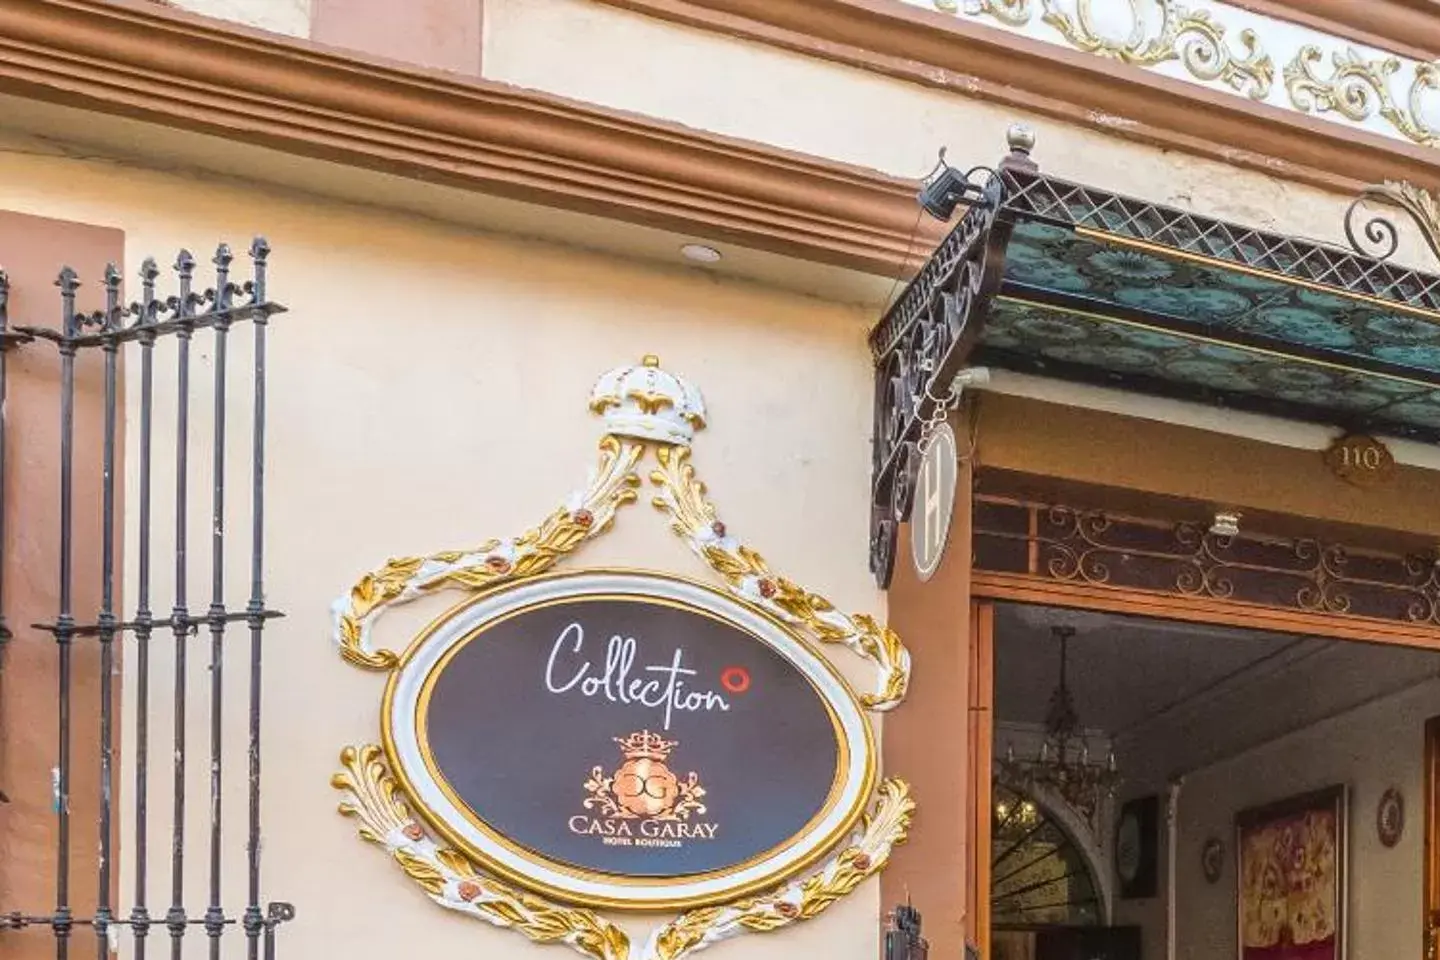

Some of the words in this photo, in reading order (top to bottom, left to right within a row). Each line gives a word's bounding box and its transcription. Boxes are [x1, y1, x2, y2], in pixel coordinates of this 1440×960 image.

[1342, 446, 1380, 469] 110
[924, 442, 942, 562] H
[545, 623, 730, 730] Collection
[568, 815, 633, 836] CASA
[640, 819, 719, 840] GARAY
[602, 836, 632, 846] HOTEL
